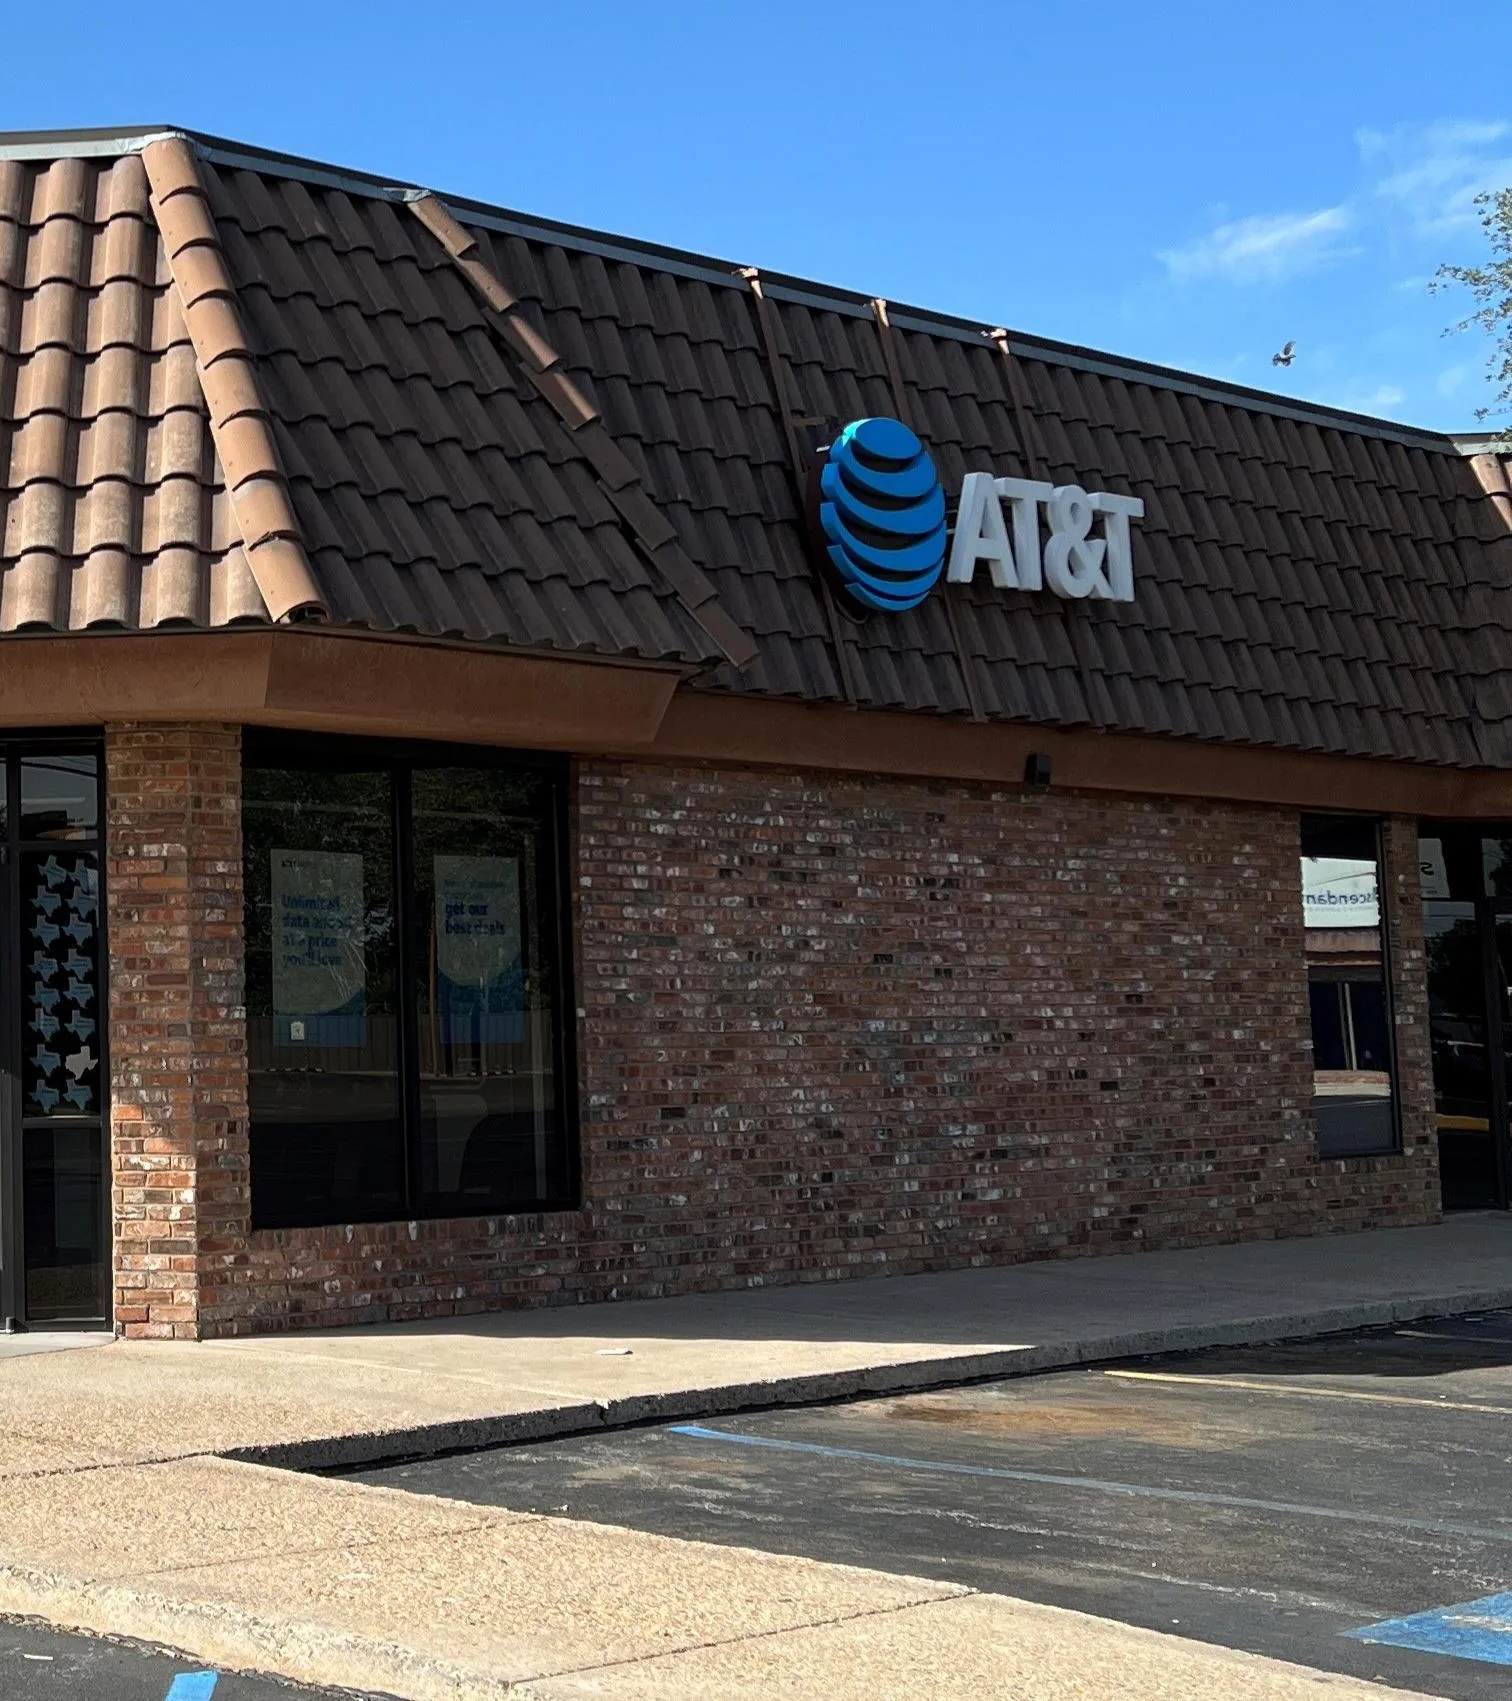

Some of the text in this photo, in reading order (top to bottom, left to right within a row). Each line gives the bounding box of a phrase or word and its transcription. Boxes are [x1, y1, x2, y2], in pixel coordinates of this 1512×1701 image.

[947, 472, 1144, 601] AT&T
[445, 901, 488, 919] get our
[445, 919, 505, 935] best deals
